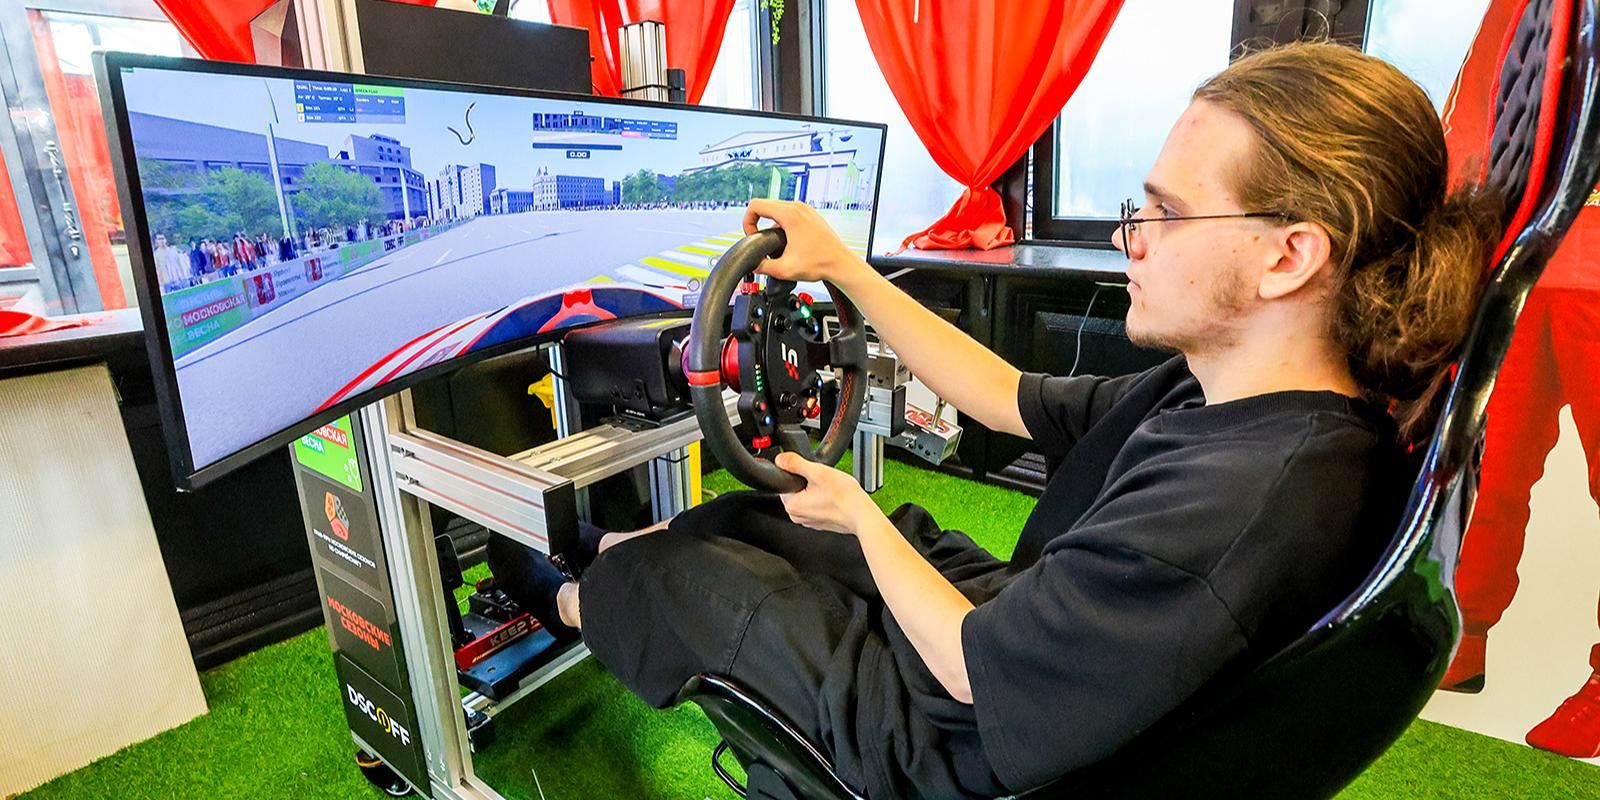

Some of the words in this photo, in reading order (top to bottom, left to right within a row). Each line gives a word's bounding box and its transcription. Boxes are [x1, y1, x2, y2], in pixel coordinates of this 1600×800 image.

[327, 595, 391, 647] МОСКОВСКИЕ
[340, 615, 380, 651] СЕЗОНЫ
[490, 620, 527, 647] KEEP
